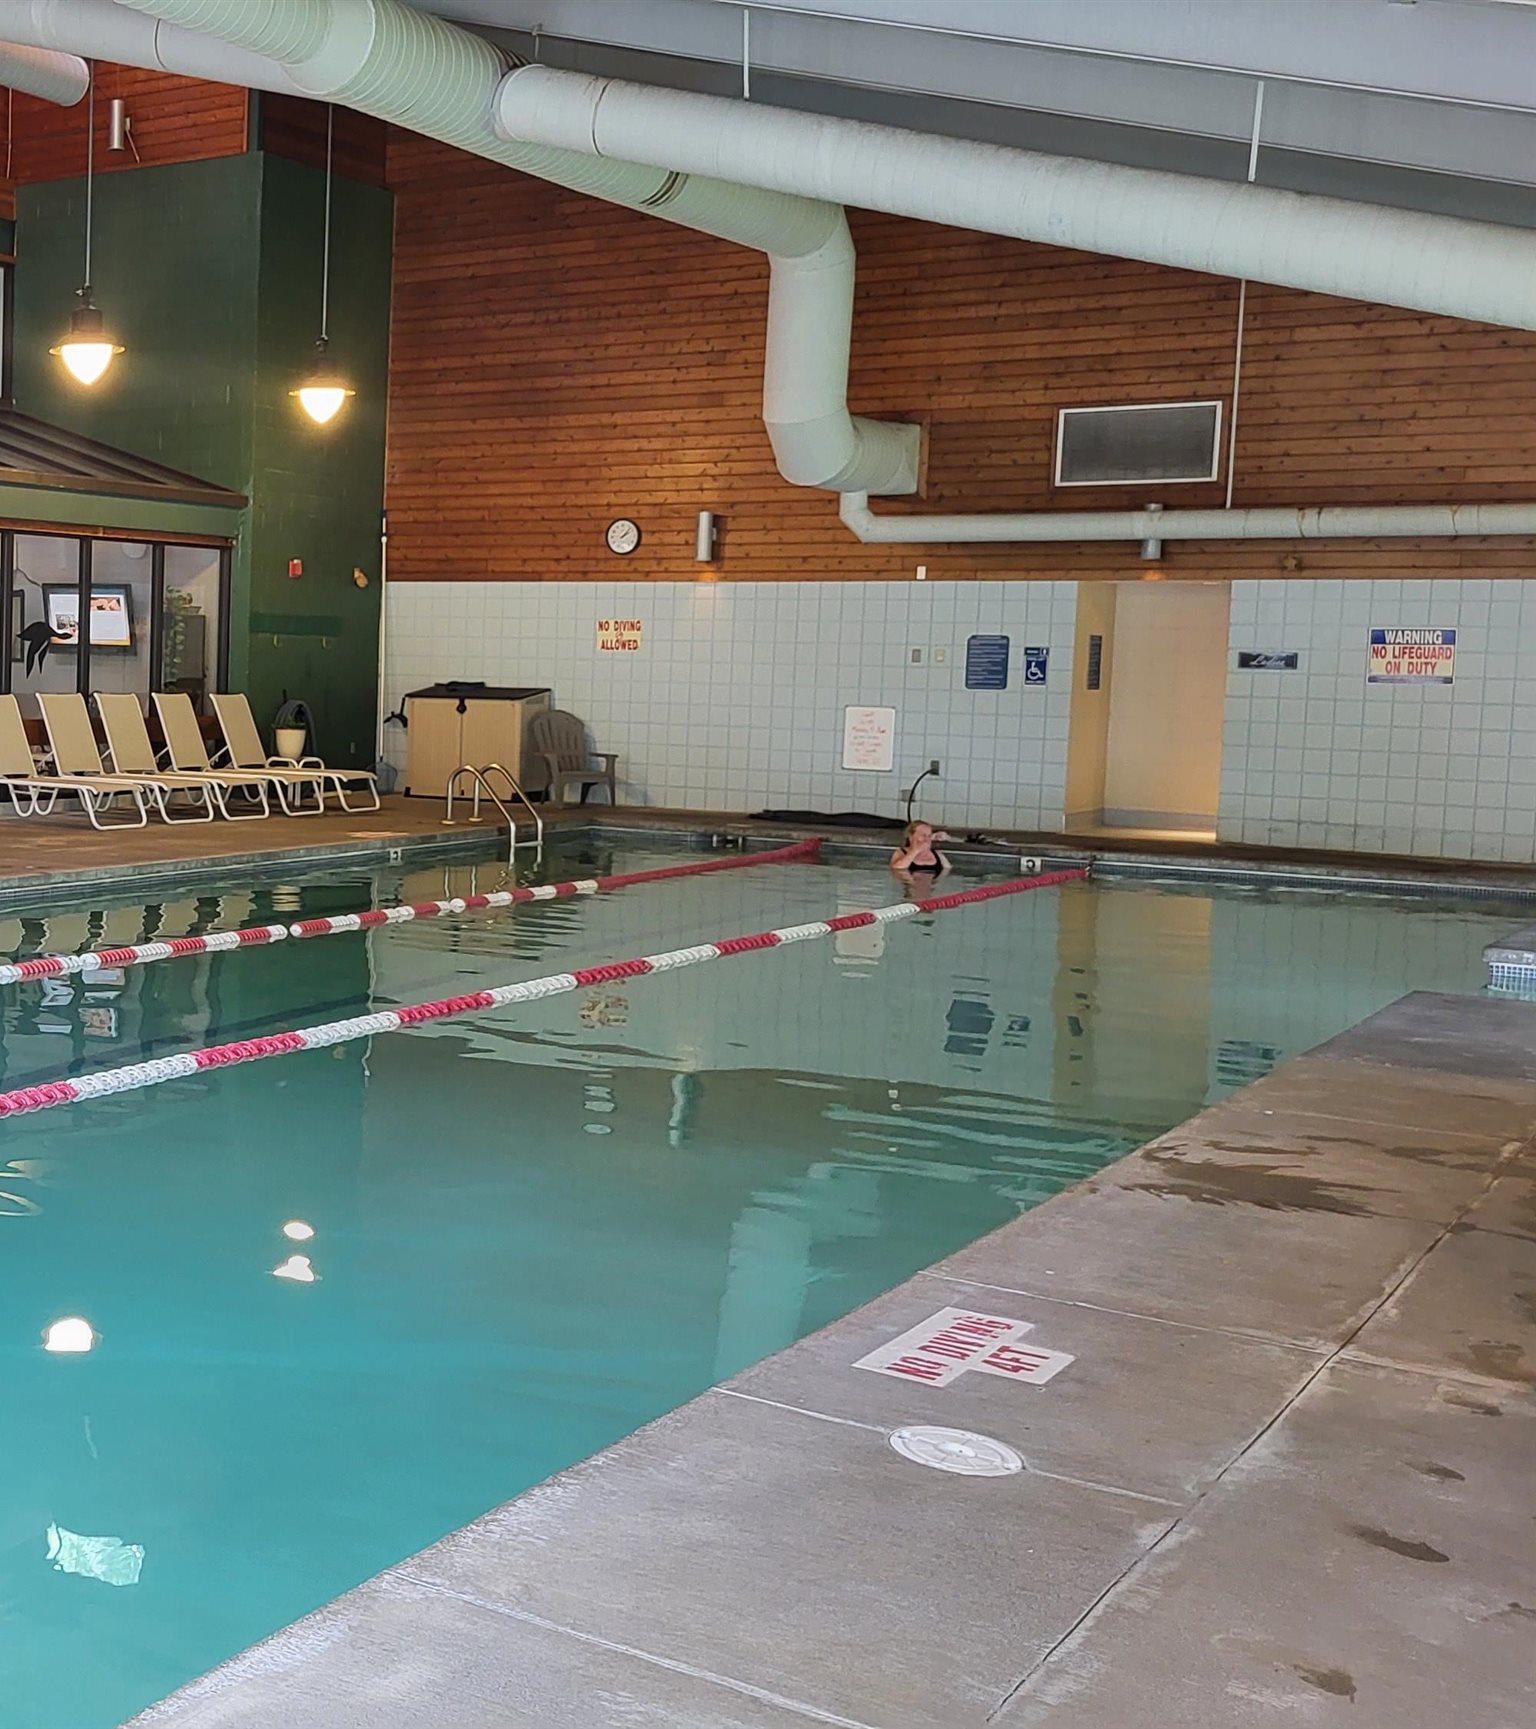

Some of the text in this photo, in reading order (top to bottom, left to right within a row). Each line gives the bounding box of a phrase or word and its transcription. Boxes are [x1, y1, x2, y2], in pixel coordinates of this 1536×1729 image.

[598, 620, 641, 631] NO DIVING
[600, 639, 639, 650] ALLOWED
[1385, 630, 1443, 645] WARNING
[1371, 646, 1453, 660] NO LIFEGUARD
[1385, 661, 1438, 675] ON DUTY
[885, 1316, 1015, 1381] NO DIVING
[981, 1345, 1051, 1374] 4FT
